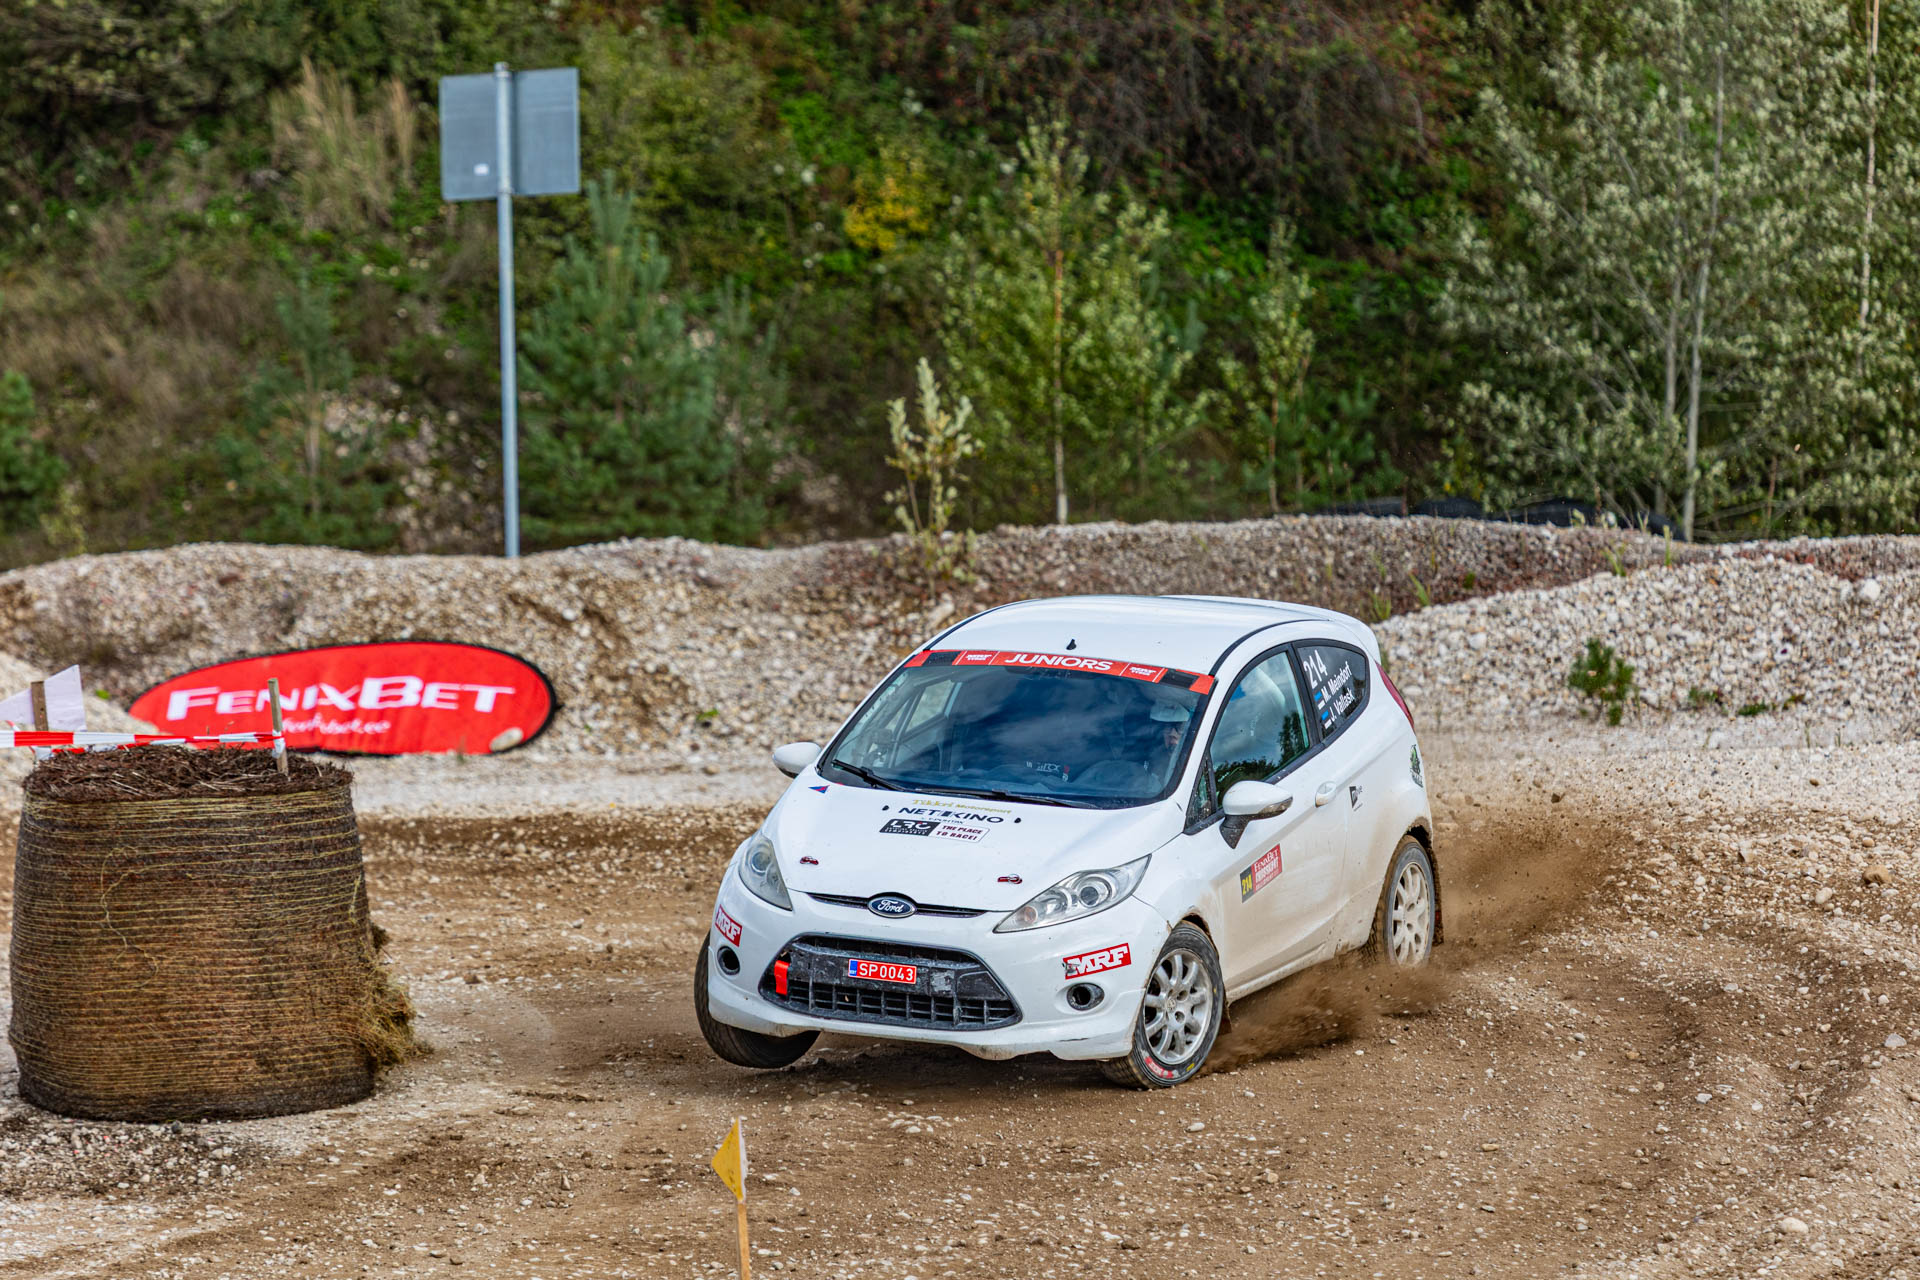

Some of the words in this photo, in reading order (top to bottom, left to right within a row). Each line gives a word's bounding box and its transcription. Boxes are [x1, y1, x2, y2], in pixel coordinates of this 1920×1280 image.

[1004, 653, 1114, 671] JUNIORS
[1303, 650, 1328, 689] 214
[1321, 685, 1331, 703] M.
[1327, 661, 1353, 696] Meindorf
[1329, 706, 1337, 722] J.
[949, 832, 977, 841] RACE!
[957, 826, 983, 835] PLACE
[1242, 874, 1252, 895] 214
[877, 900, 904, 913] Ford
[715, 907, 741, 941] MRF
[1066, 946, 1128, 976] MRF
[859, 963, 914, 981] SP0043
